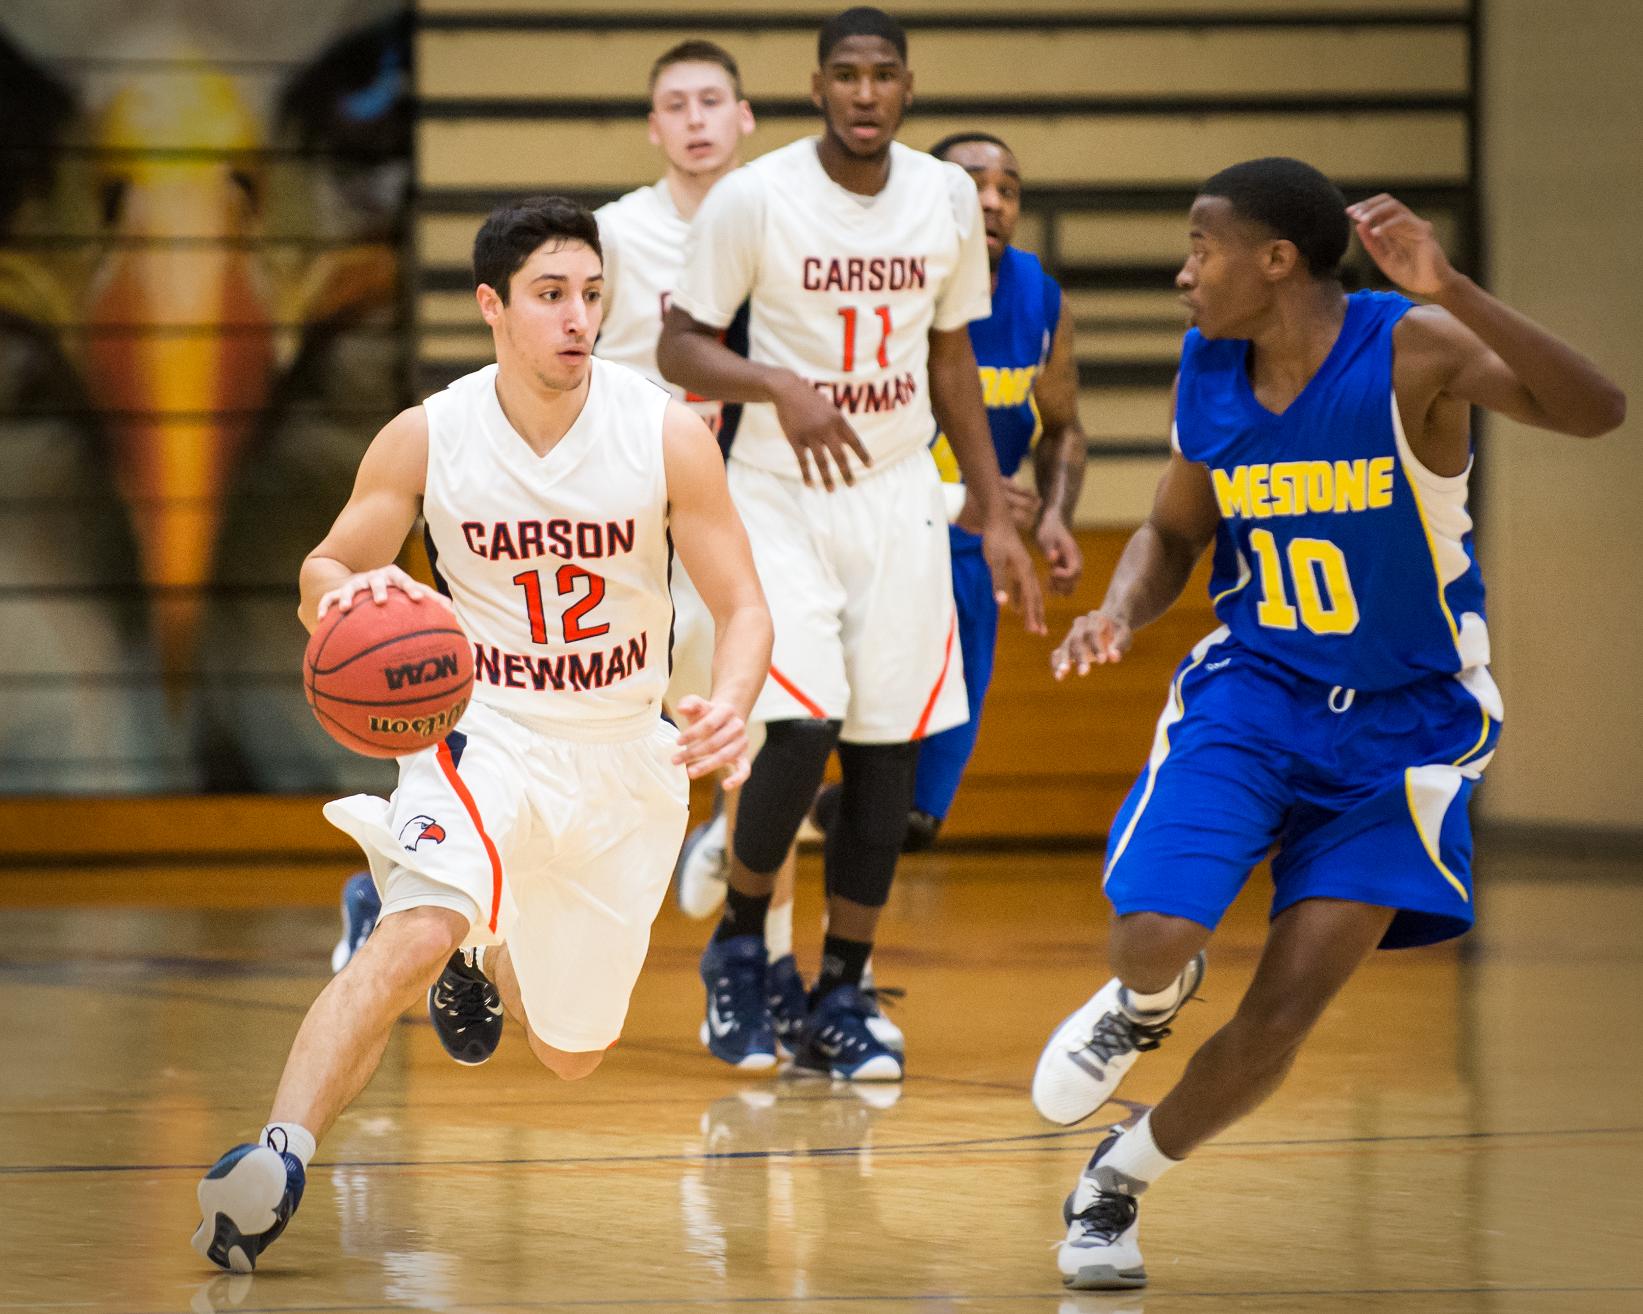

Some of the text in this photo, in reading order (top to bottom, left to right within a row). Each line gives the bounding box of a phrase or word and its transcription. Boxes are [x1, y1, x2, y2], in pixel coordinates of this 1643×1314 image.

[803, 256, 926, 292] CARSON
[837, 304, 891, 373] 11
[813, 372, 916, 415] WMAN
[1212, 456, 1395, 519] MESTONE
[461, 518, 635, 561] CARSON
[512, 564, 611, 645] 12
[1248, 528, 1361, 636] 10
[383, 653, 459, 691] NCAA
[473, 630, 648, 692] NEWMAN
[367, 697, 468, 738] Wilson
